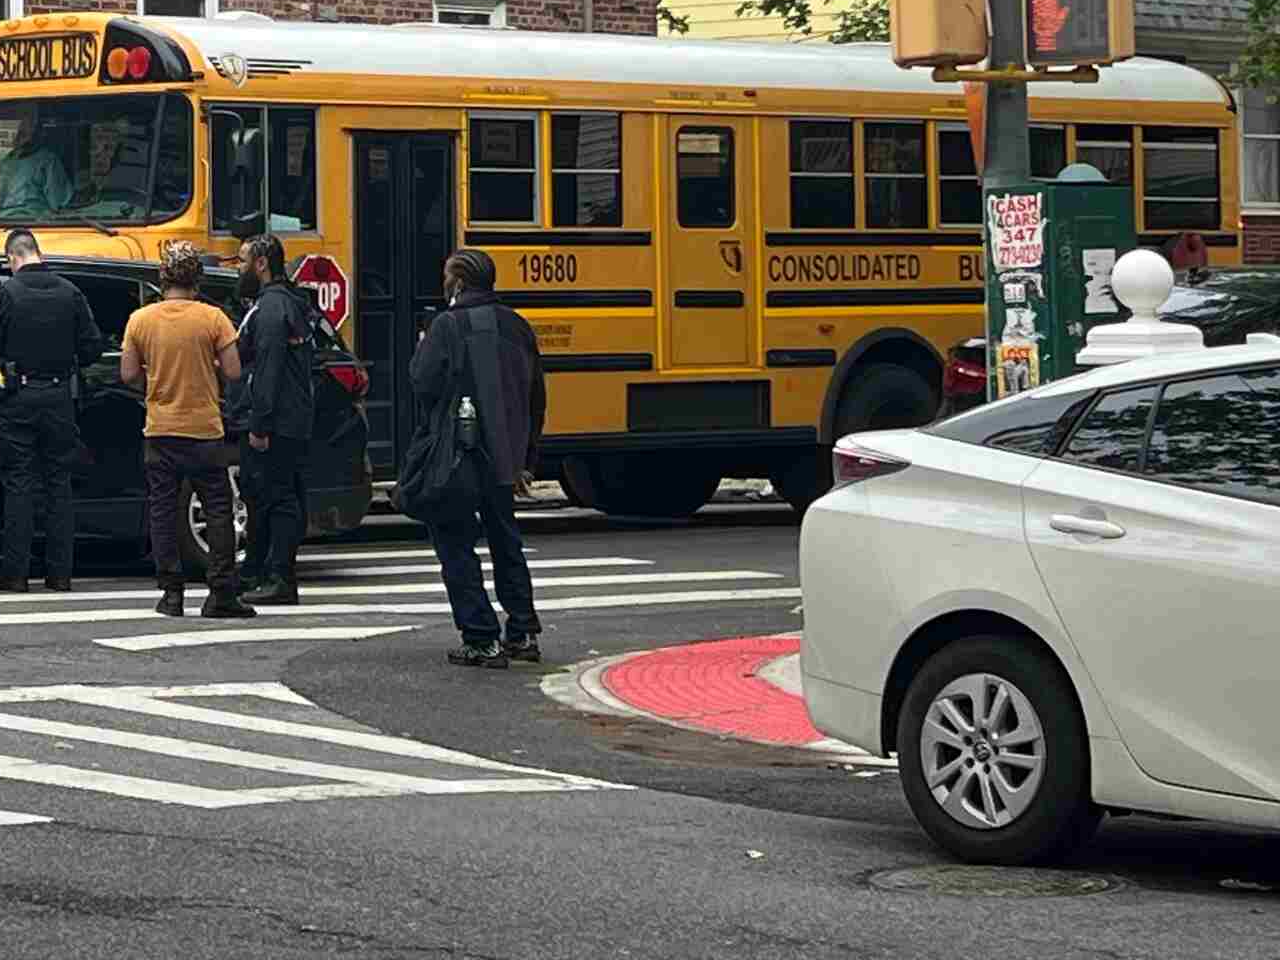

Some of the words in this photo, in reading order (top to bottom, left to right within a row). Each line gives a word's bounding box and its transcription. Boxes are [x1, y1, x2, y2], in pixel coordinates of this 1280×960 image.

[63, 37, 93, 75] BUS
[1002, 228, 1037, 243] 347
[519, 254, 577, 283] 19680
[768, 254, 921, 282] CONSOLIDATED
[959, 255, 984, 281] BU
